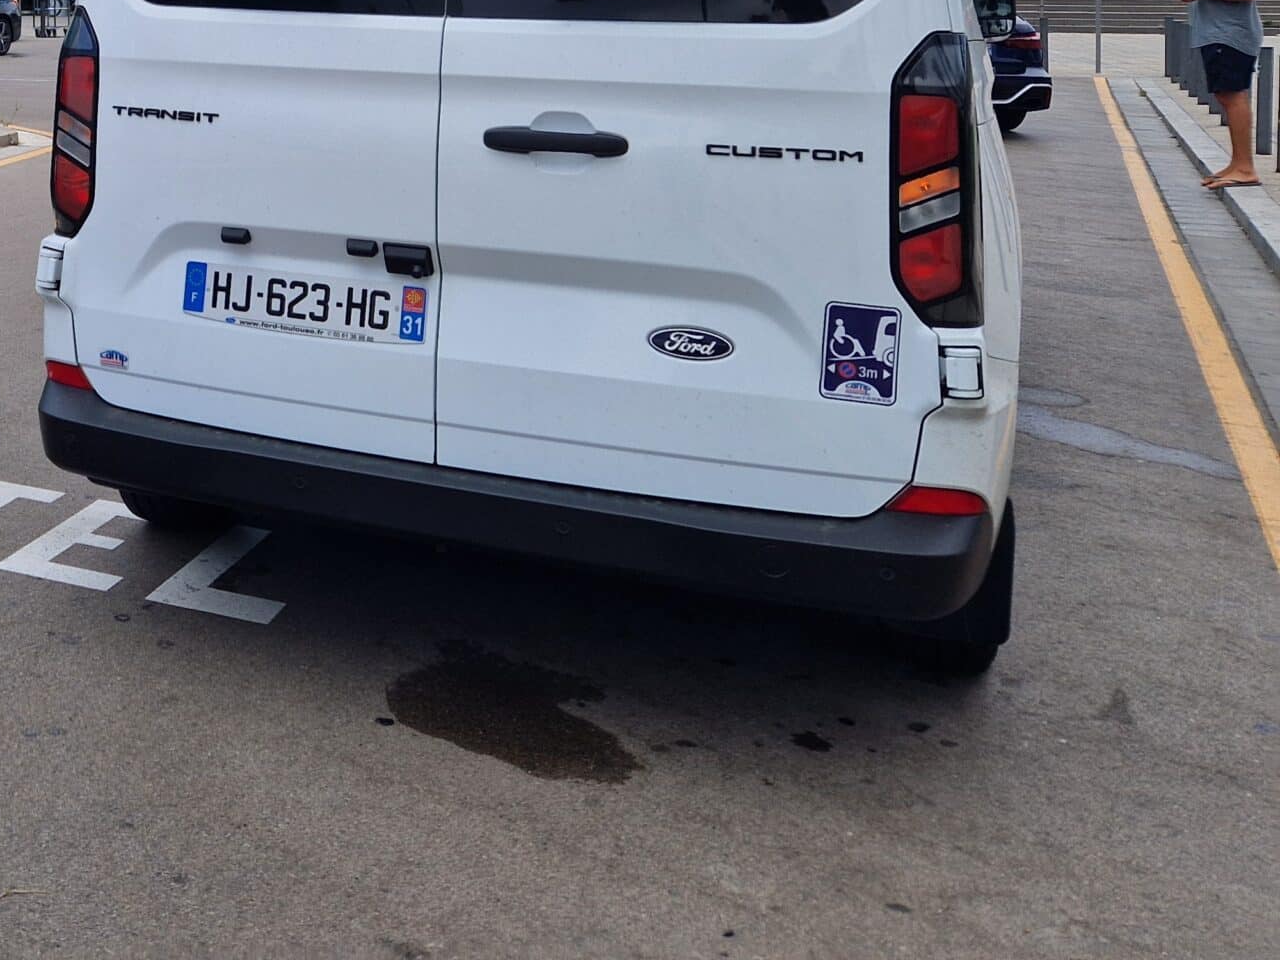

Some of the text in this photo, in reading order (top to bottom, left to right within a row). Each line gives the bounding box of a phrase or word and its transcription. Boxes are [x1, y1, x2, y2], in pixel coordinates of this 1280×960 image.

[112, 105, 220, 124] TRANSIT
[705, 143, 864, 163] CUSTOM
[191, 291, 199, 303] F
[211, 271, 391, 330] HJ-623-HG
[402, 315, 423, 336] 31
[663, 330, 716, 356] Ford
[858, 366, 878, 380] 3m
